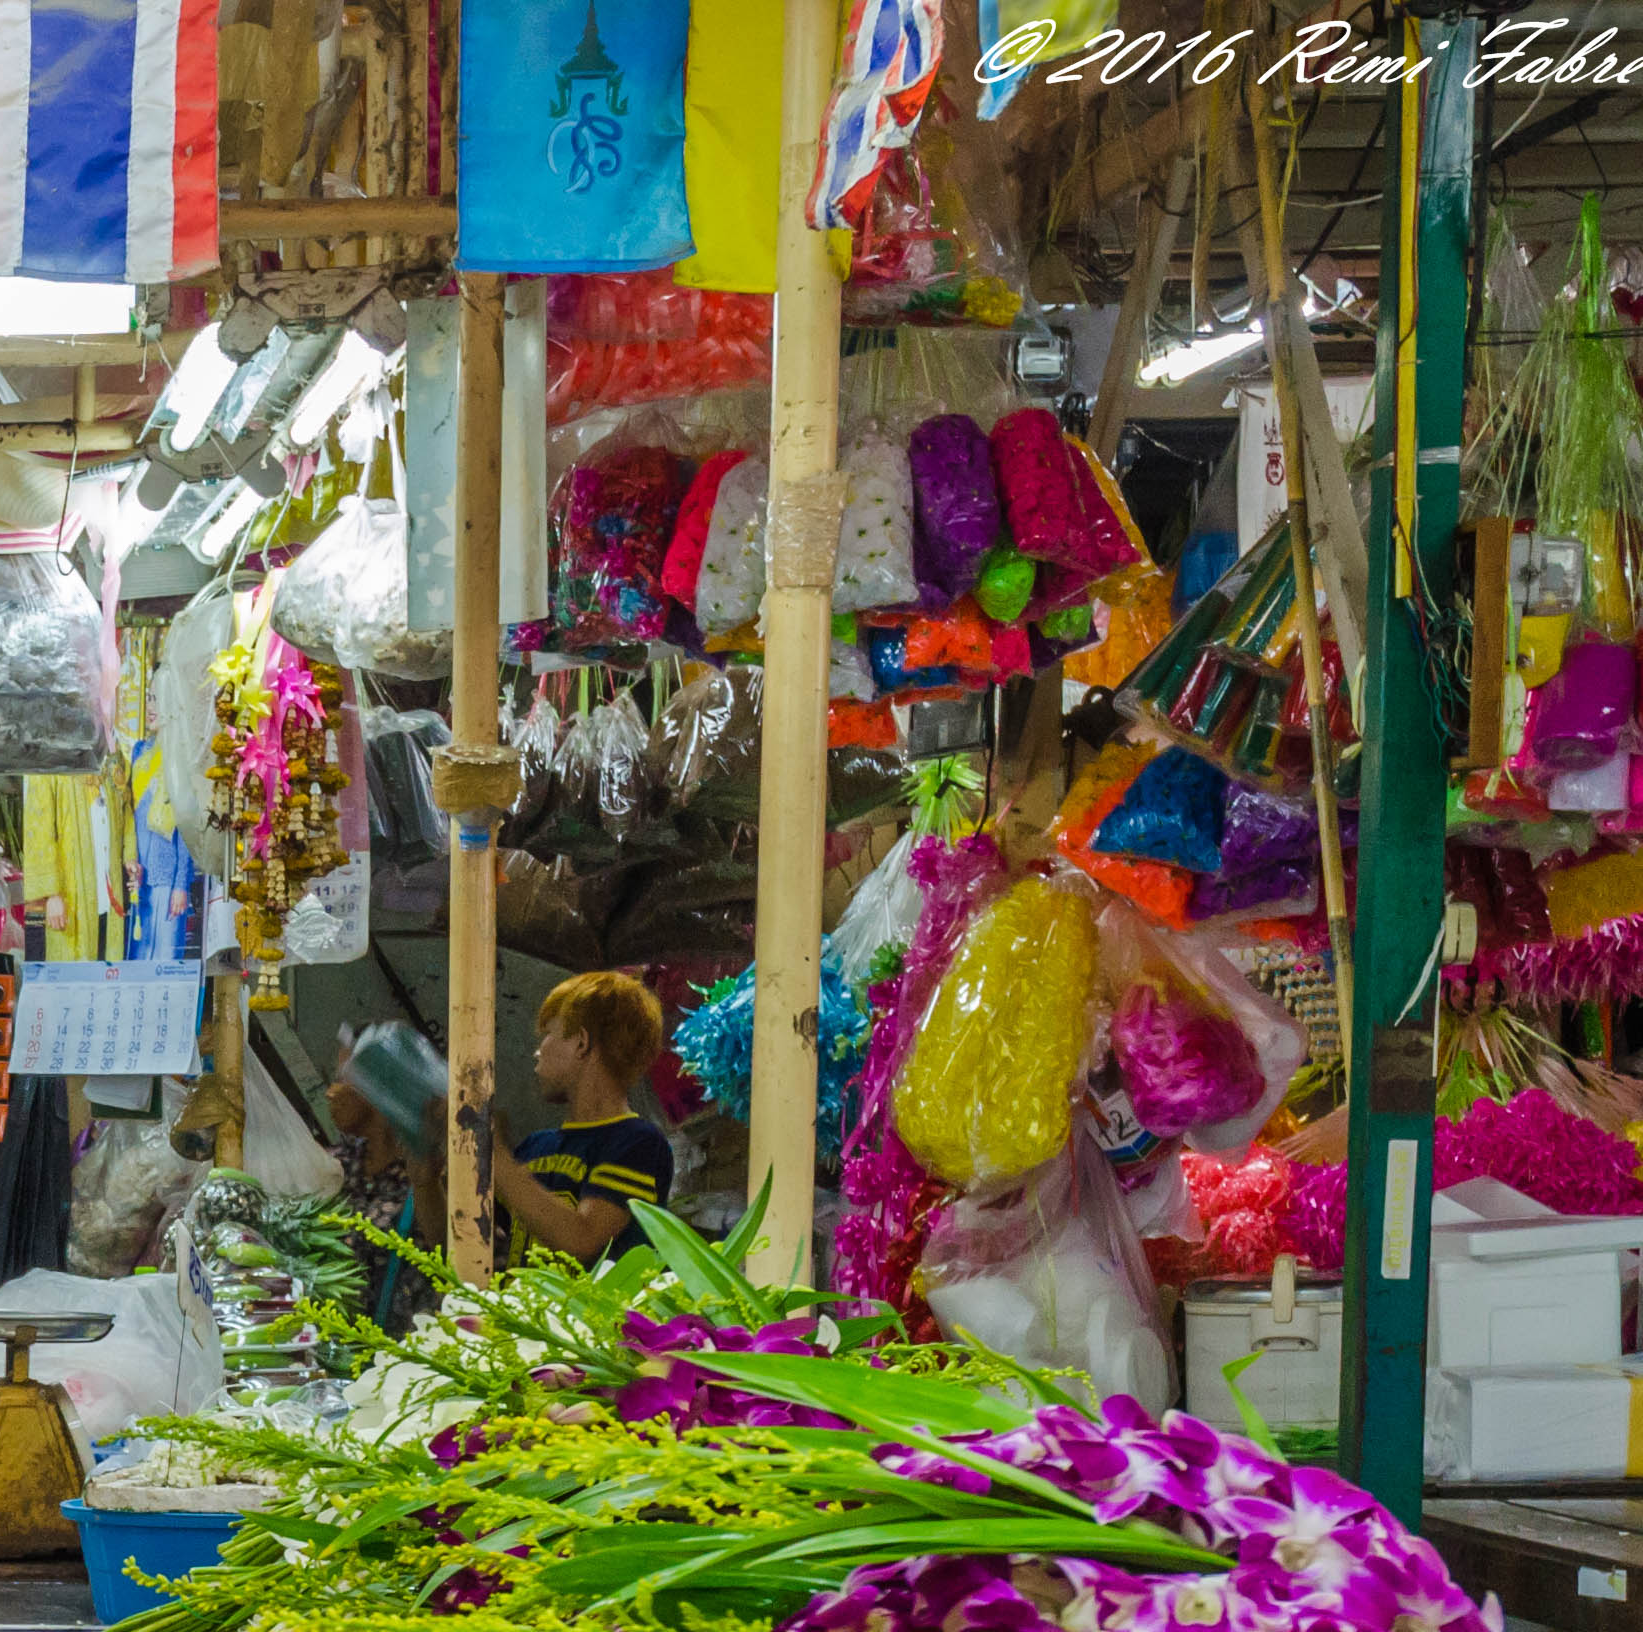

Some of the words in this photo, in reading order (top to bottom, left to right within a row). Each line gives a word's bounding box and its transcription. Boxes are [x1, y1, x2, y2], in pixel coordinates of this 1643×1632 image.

[90, 992, 95, 1003] 1
[115, 991, 121, 1003] 2
[139, 991, 145, 1002] 3
[163, 990, 169, 1001] 4
[37, 1008, 43, 1020] 6
[63, 1008, 70, 1020] 7
[88, 1008, 94, 1020] 8
[113, 1007, 120, 1020] 9
[133, 1007, 144, 1020] 10
[157, 1007, 168, 1019] 11
[182, 1007, 193, 1019] 12
[30, 1025, 42, 1037] 13
[57, 1025, 68, 1037] 14
[82, 1024, 94, 1036] 15
[107, 1024, 118, 1036] 16
[131, 1024, 143, 1036] 17
[156, 1024, 168, 1036] 18
[27, 1041, 41, 1053] 20
[52, 1042, 66, 1053] 21
[78, 1041, 91, 1054] 22
[103, 1041, 116, 1053] 23
[128, 1041, 141, 1053] 24
[153, 1041, 166, 1053] 25
[24, 1057, 39, 1069] 27
[49, 1058, 64, 1070] 28
[74, 1057, 88, 1070] 29
[100, 1057, 115, 1070] 30
[125, 1057, 138, 1070] 31
